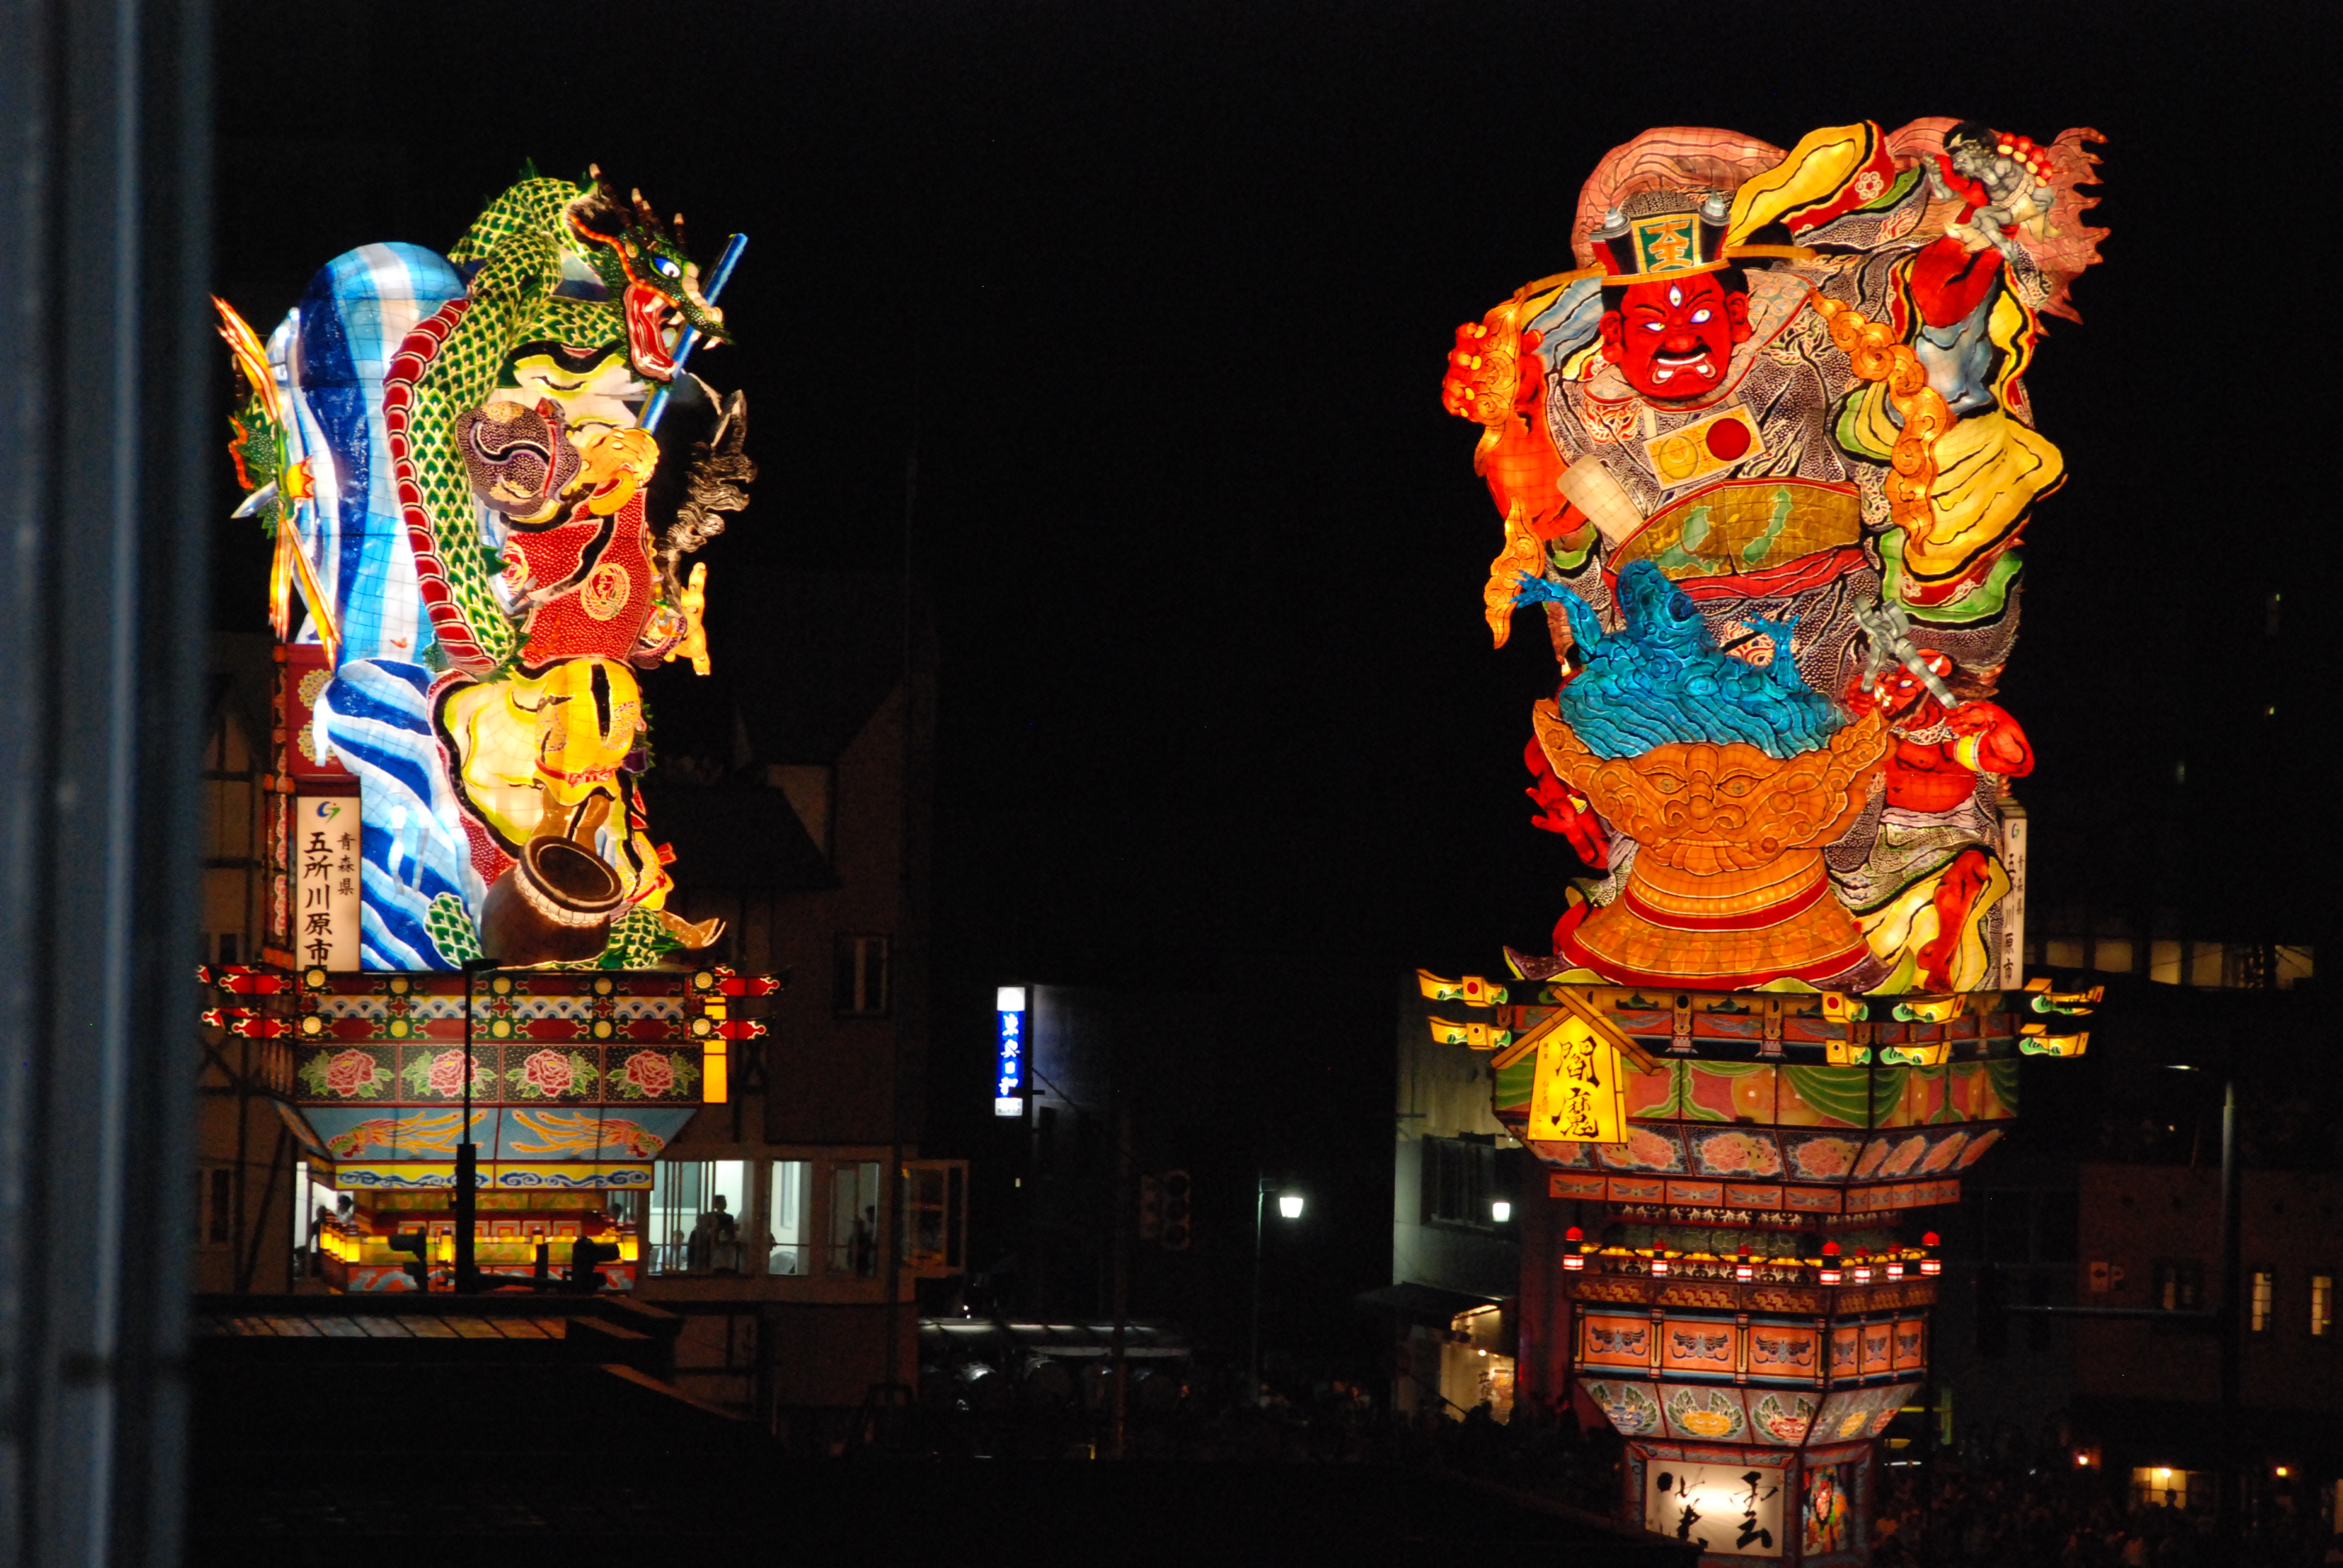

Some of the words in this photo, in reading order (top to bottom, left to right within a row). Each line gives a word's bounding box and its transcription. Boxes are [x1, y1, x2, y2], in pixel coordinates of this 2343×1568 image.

[303, 832, 333, 966] 五所川原市
[337, 832, 356, 896] 青森県
[1552, 1035, 1601, 1138] 閻魔
